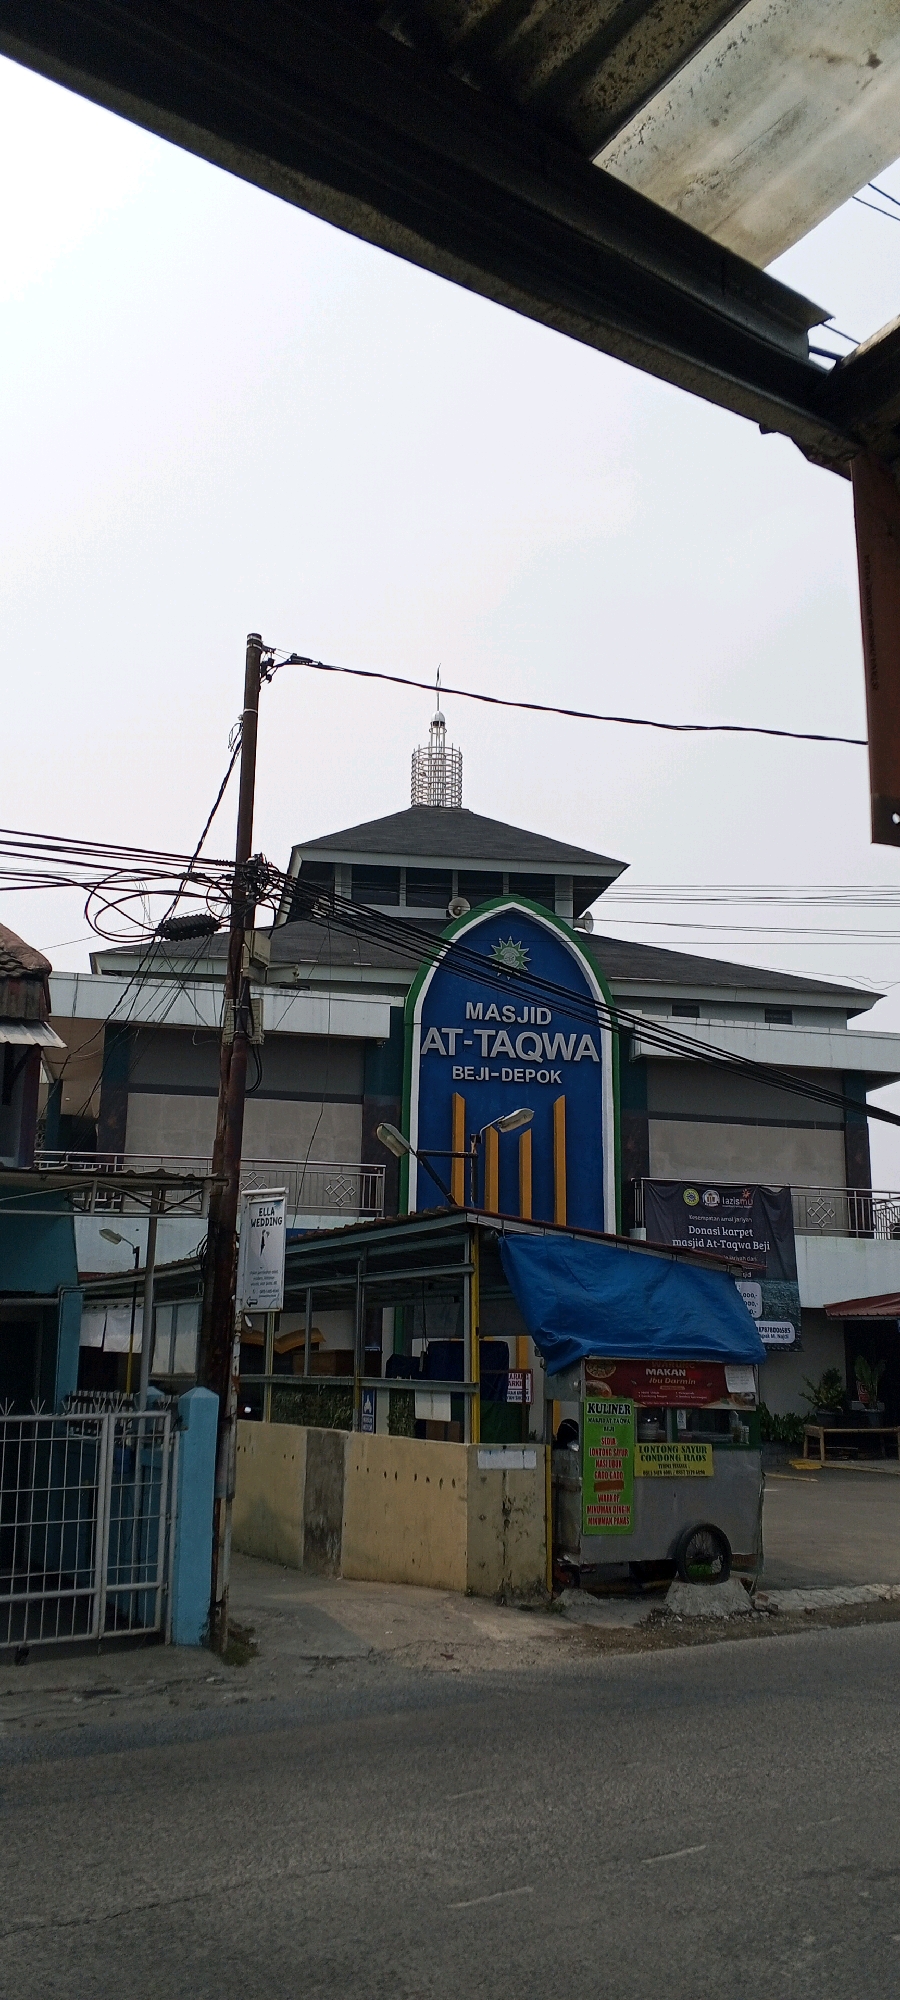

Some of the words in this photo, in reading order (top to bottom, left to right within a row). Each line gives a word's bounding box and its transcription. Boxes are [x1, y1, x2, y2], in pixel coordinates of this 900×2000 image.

[465, 1001, 552, 1025] MASJID
[420, 1027, 600, 1063] AT-TAQWA
[452, 1066, 563, 1084] BEJI-DEPOK
[259, 1207, 275, 1217] ELLA
[250, 1216, 283, 1228] WEDDING
[688, 1226, 721, 1236] Donasi
[722, 1227, 754, 1239] karpet
[672, 1238, 704, 1249] masjid
[706, 1239, 751, 1251] At-Taqwa
[753, 1241, 770, 1252] Beji
[645, 1368, 686, 1377] MAKAN
[587, 1403, 631, 1415] KULINER
[589, 1447, 612, 1457] LONTONG
[639, 1445, 679, 1454] LONTONG
[681, 1446, 707, 1454] SAYUR
[640, 1454, 681, 1462] CONDONG
[683, 1454, 707, 1462] RAOS
[595, 1459, 609, 1468] NASI
[587, 1505, 612, 1515] MINUMAN
[588, 1516, 613, 1526] MINUMAN
